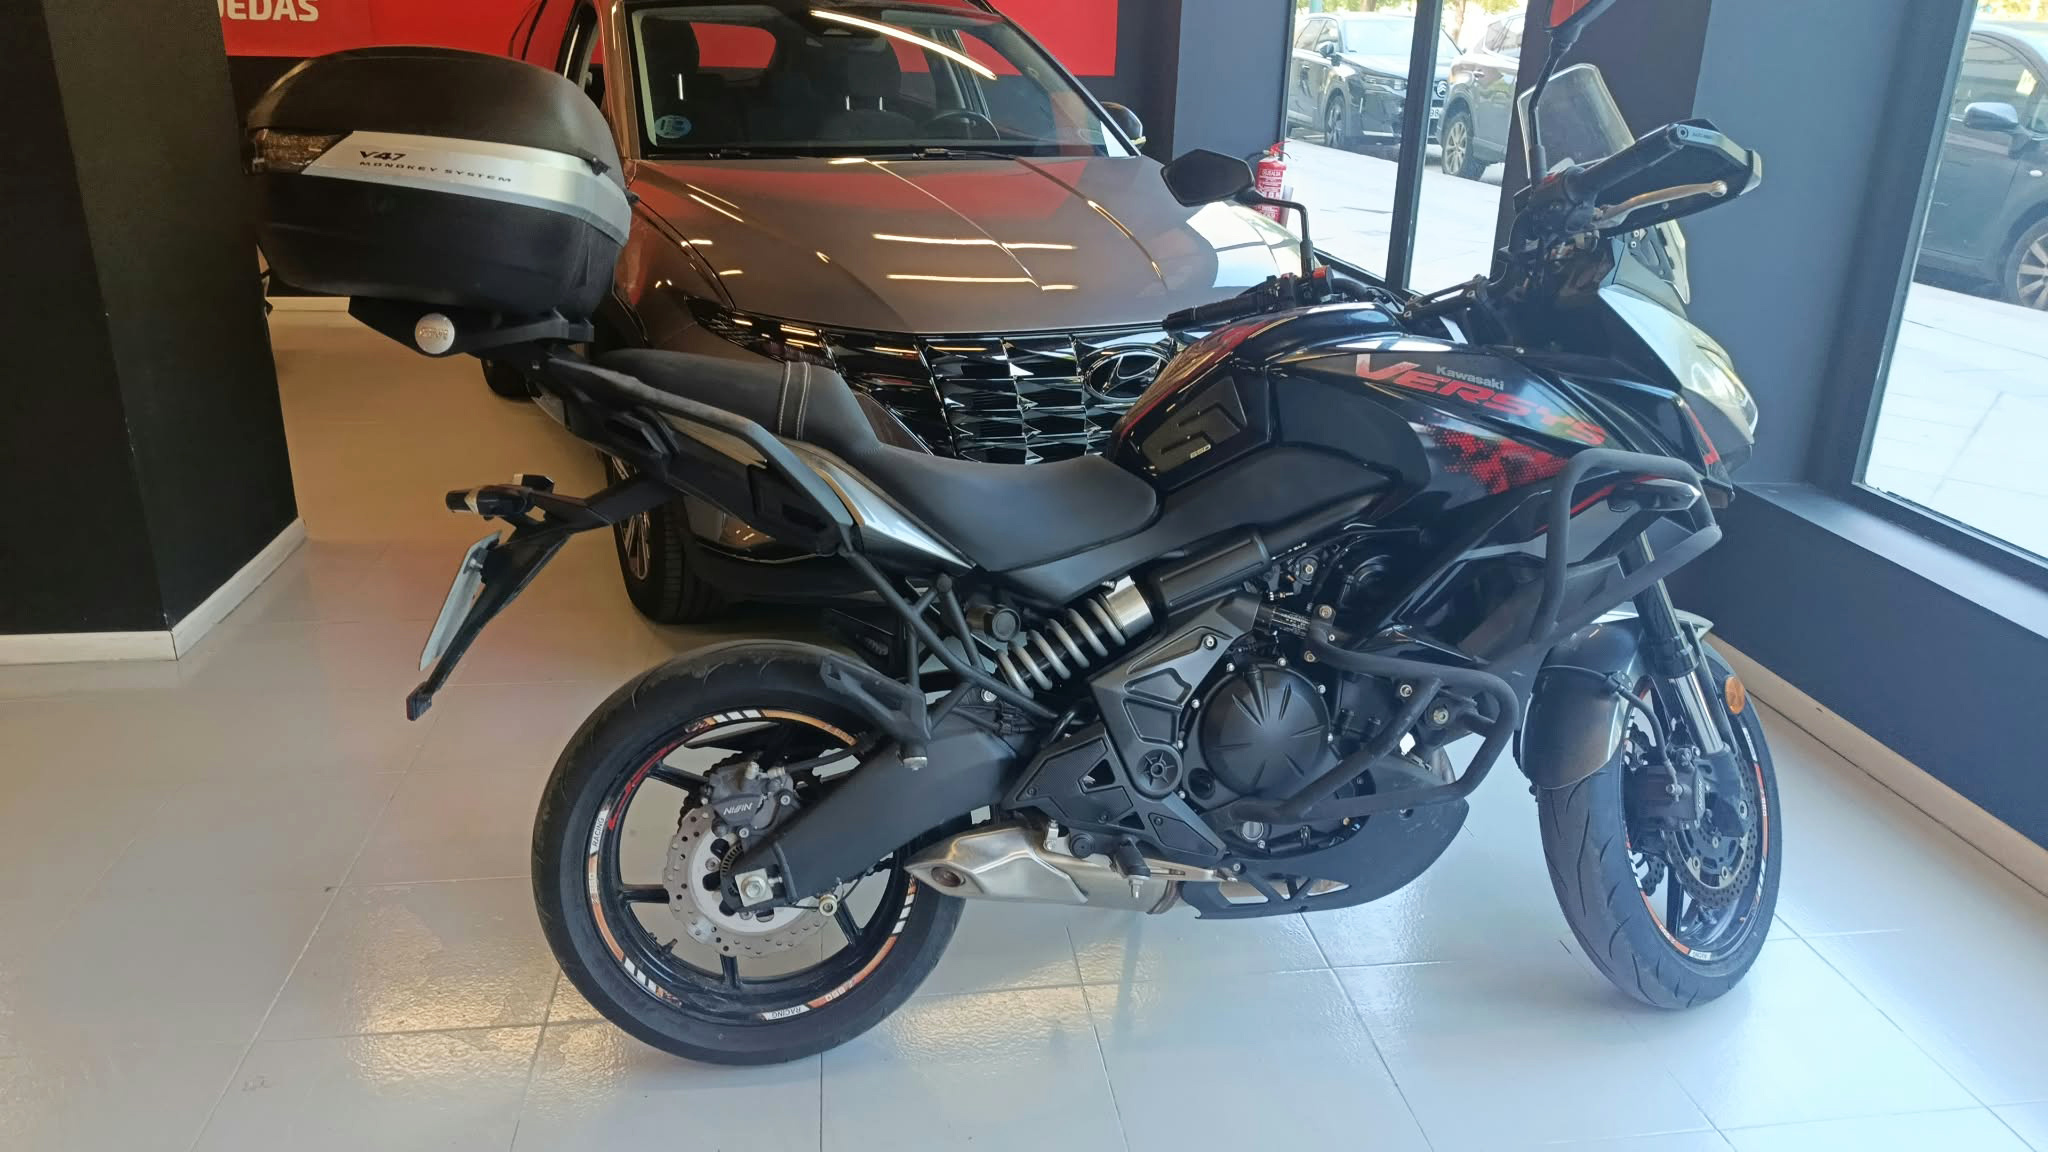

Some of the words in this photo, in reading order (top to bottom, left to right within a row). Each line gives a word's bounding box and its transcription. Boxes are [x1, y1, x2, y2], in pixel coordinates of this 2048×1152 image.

[360, 151, 406, 160] V47
[360, 161, 438, 172] MONOKEY
[444, 169, 512, 183] SYSTEM
[1436, 365, 1505, 390] Kawasaki
[1356, 353, 1607, 446] VERSYS
[591, 817, 605, 847] RACING
[771, 1006, 802, 1019] RACING
